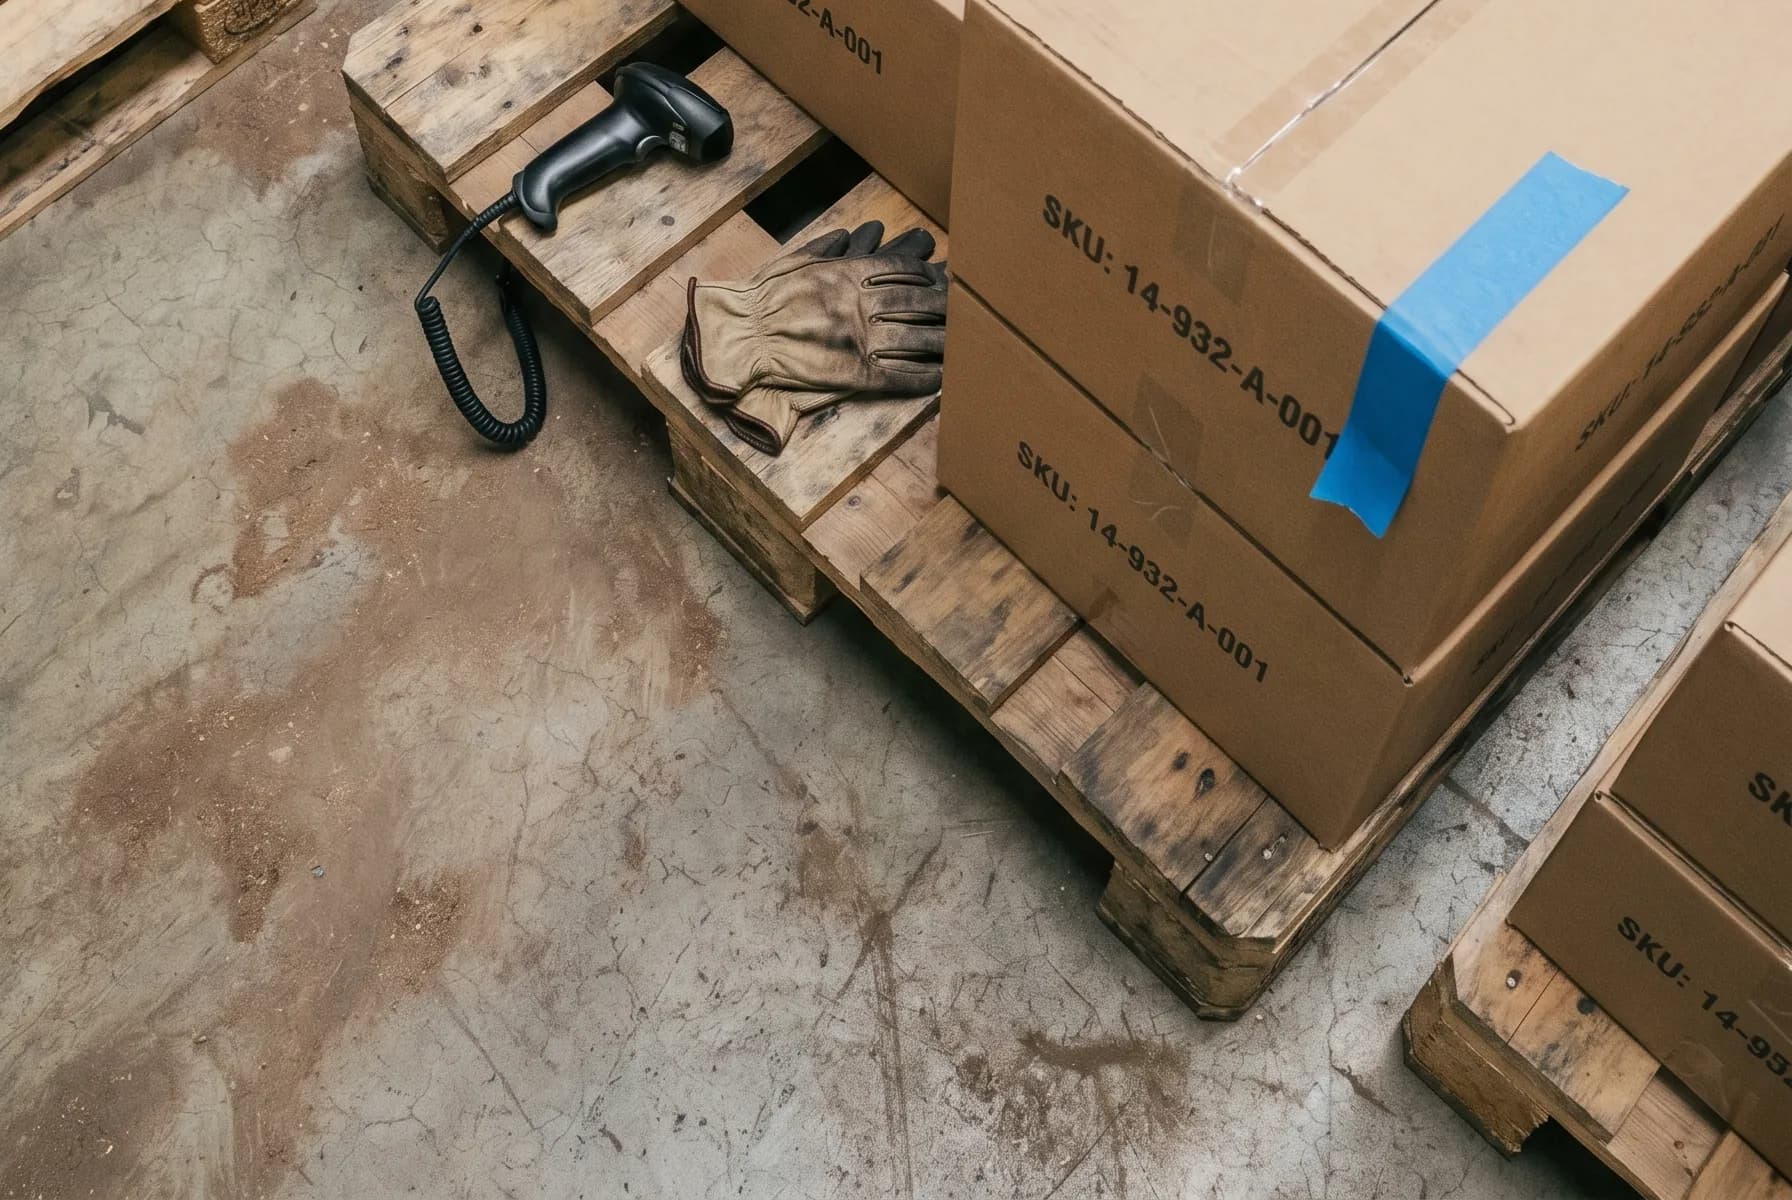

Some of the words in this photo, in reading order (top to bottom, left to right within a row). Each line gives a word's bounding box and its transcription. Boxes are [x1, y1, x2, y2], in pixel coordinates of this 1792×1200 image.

[1042, 194, 1113, 275] SKU:
[1124, 264, 1341, 461] 14-932-A-001
[1017, 441, 1078, 512] SKU:
[1088, 506, 1268, 683] 14-932-A-001
[1617, 916, 1691, 988] SKU:
